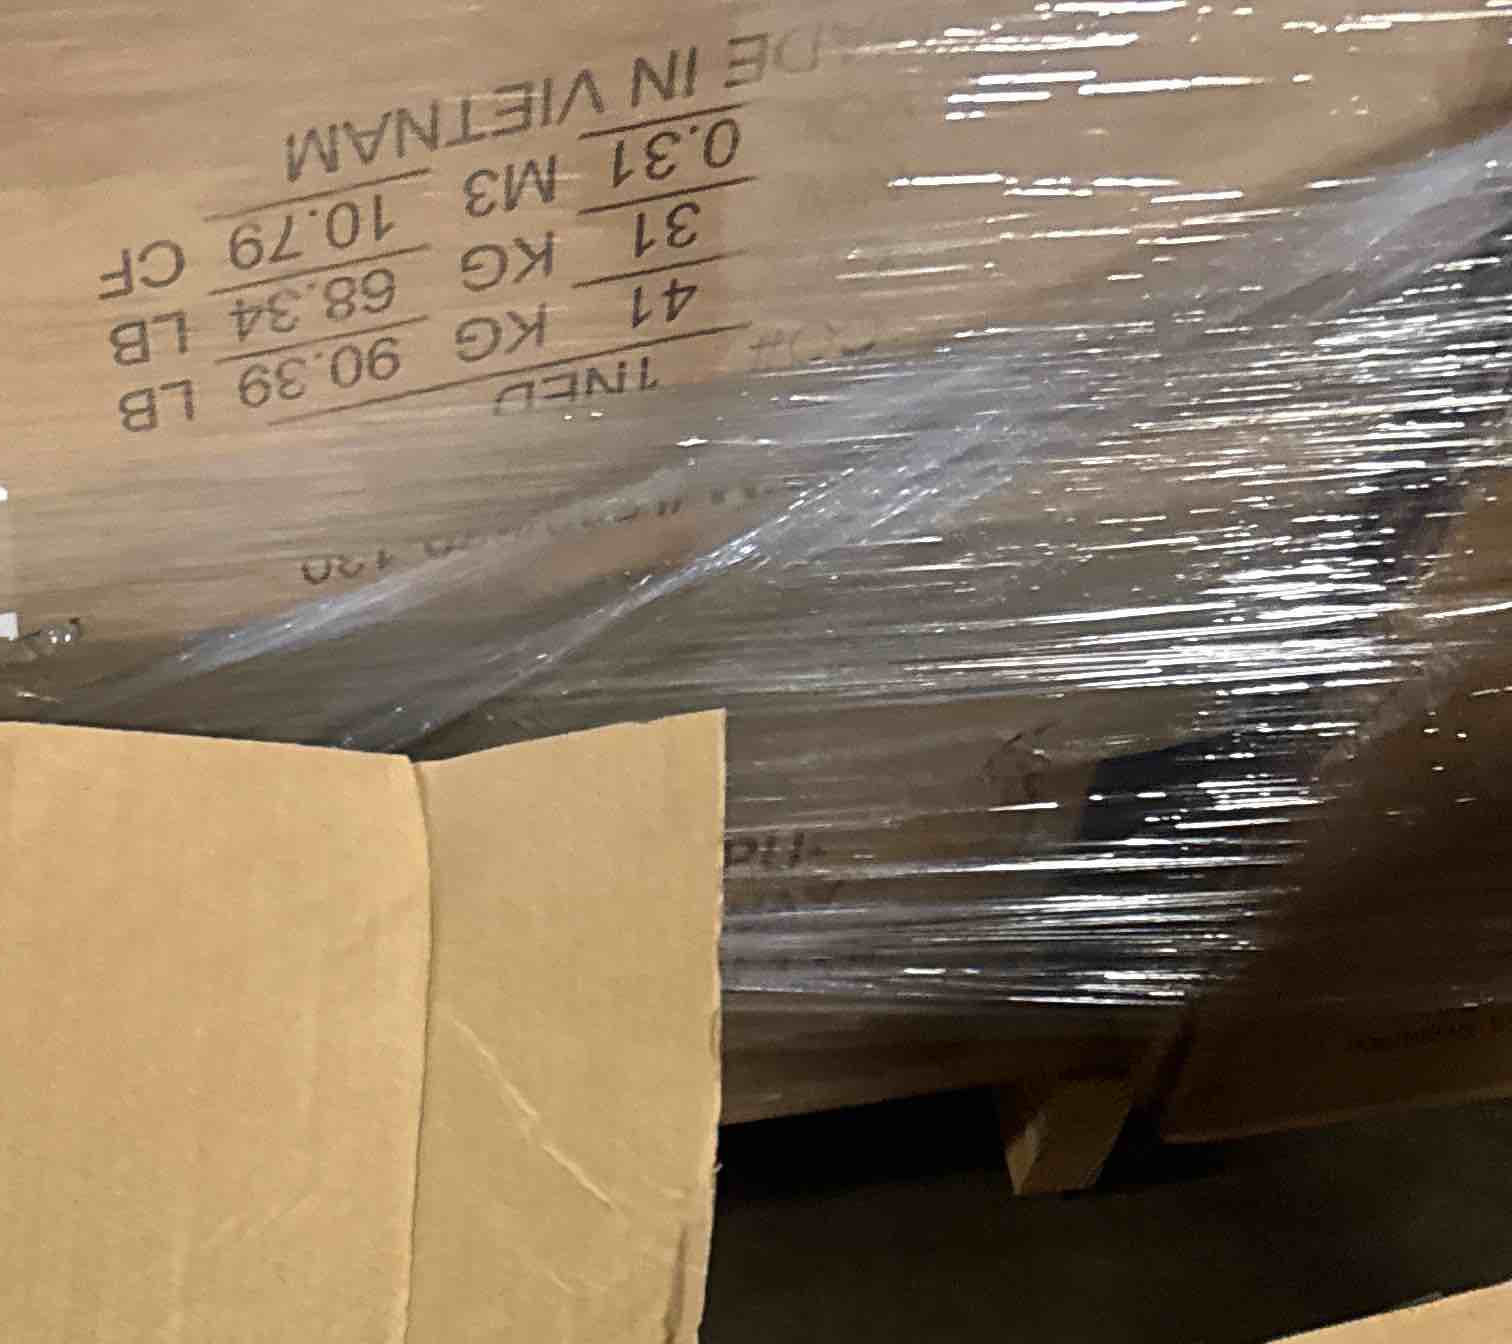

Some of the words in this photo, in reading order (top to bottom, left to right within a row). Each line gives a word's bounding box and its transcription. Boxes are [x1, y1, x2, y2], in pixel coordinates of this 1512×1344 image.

[630, 45, 698, 107] IN
[285, 70, 603, 183] VIETNAM
[609, 116, 743, 190] 0.31
[461, 153, 558, 219] M3
[228, 190, 398, 268] 10.79
[631, 199, 702, 262] 31
[98, 237, 187, 303] CF
[459, 229, 557, 296] KG
[231, 266, 398, 340] 68.34
[452, 301, 549, 365] KG
[628, 278, 700, 333] 41
[107, 309, 192, 369] LB
[236, 334, 403, 411] 90.39
[117, 376, 197, 436] LB
